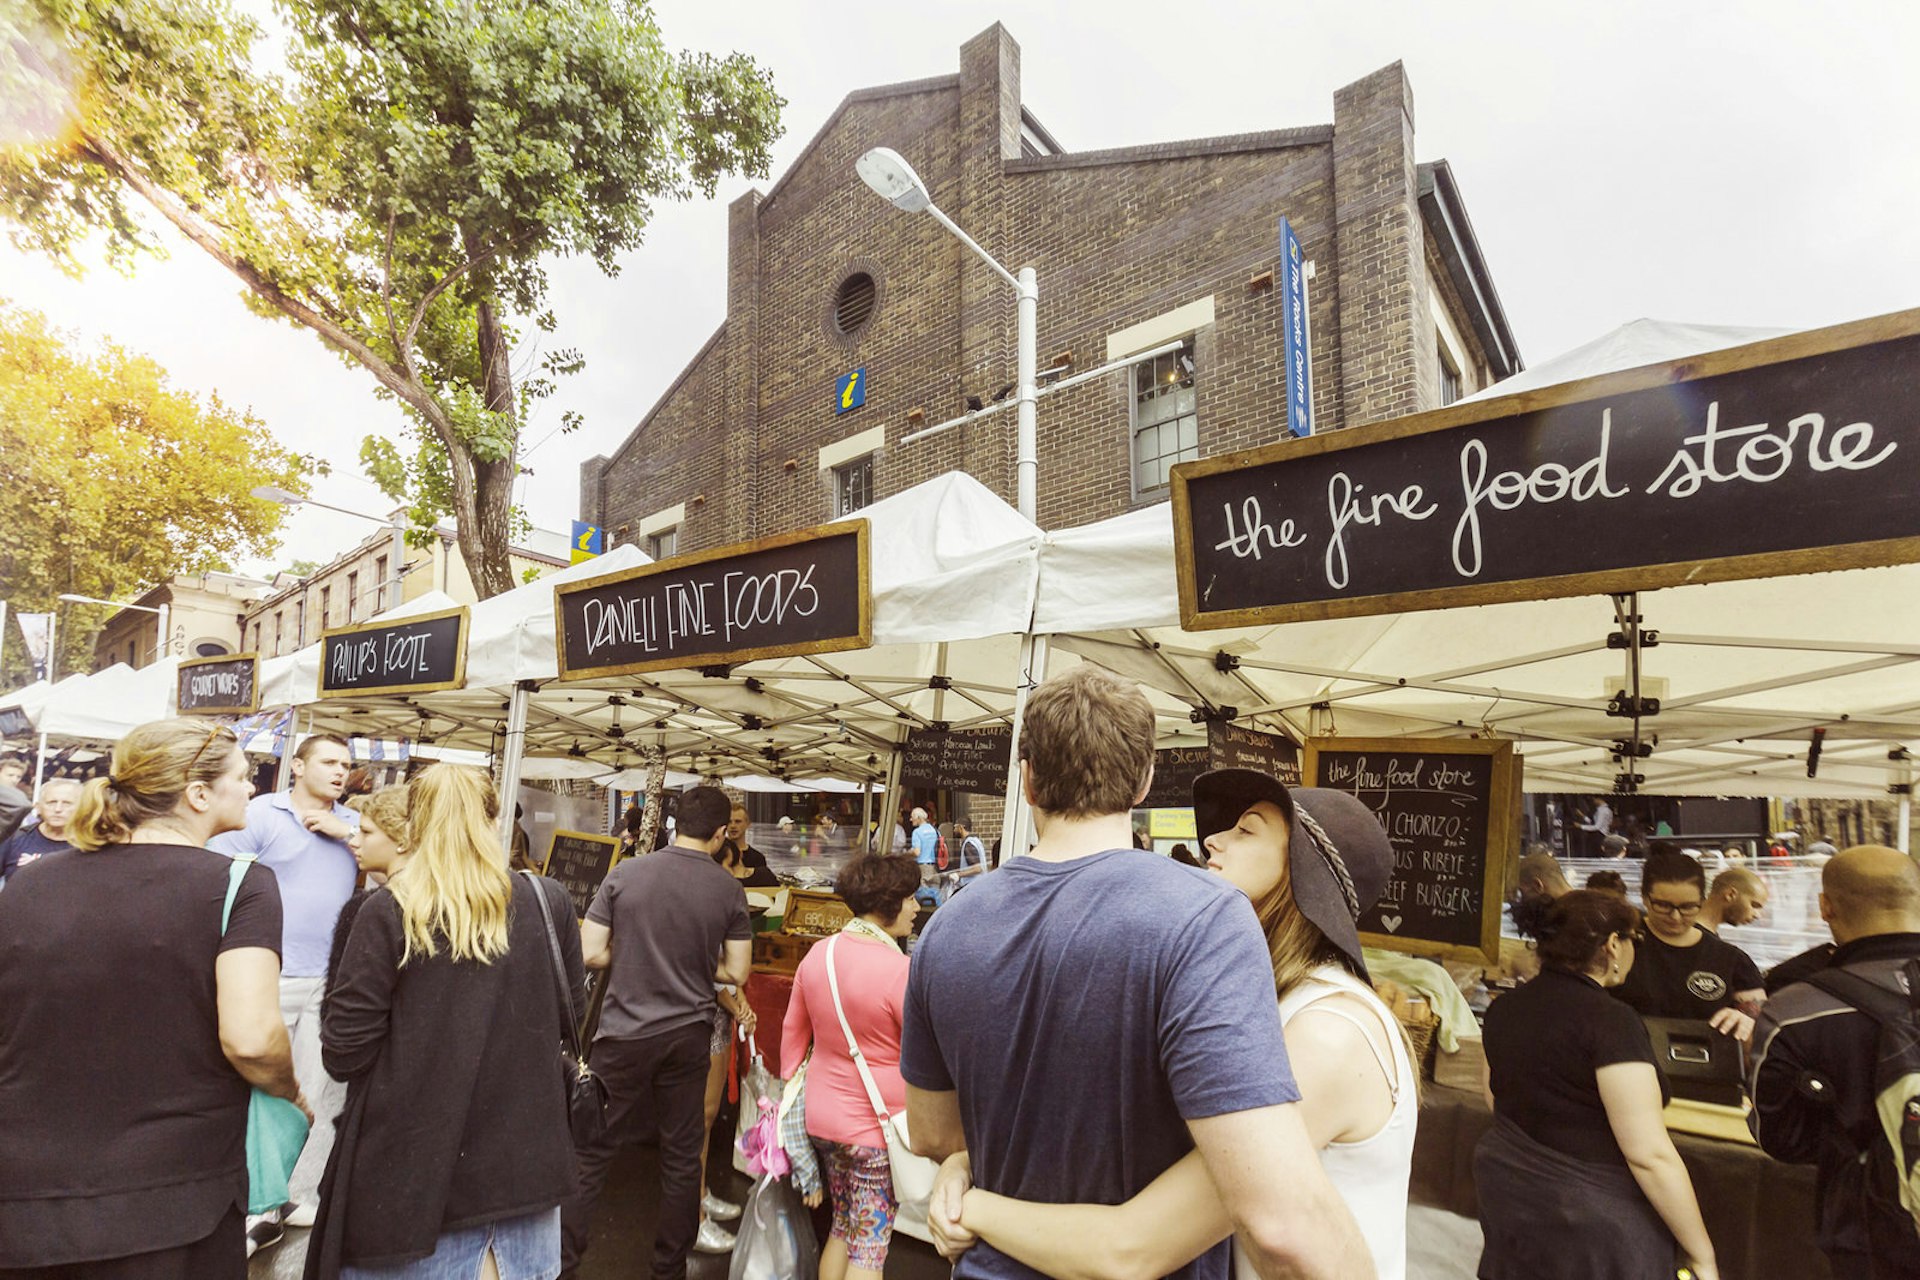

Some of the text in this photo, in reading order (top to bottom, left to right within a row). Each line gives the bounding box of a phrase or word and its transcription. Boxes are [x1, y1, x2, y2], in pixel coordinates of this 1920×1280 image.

[1291, 263, 1304, 404] The Rocks Centre
[1215, 401, 1898, 590] the fine food store
[583, 563, 819, 655] DANIELI FINE FOODS
[383, 632, 433, 680] FOOTE
[1328, 759, 1350, 783] the
[1347, 756, 1384, 799] fine
[1376, 758, 1425, 811] food
[1429, 761, 1476, 790] store
[1395, 812, 1461, 838] CHORIZO
[1422, 850, 1466, 875] RIBEYE
[1416, 882, 1473, 914] BURGER
